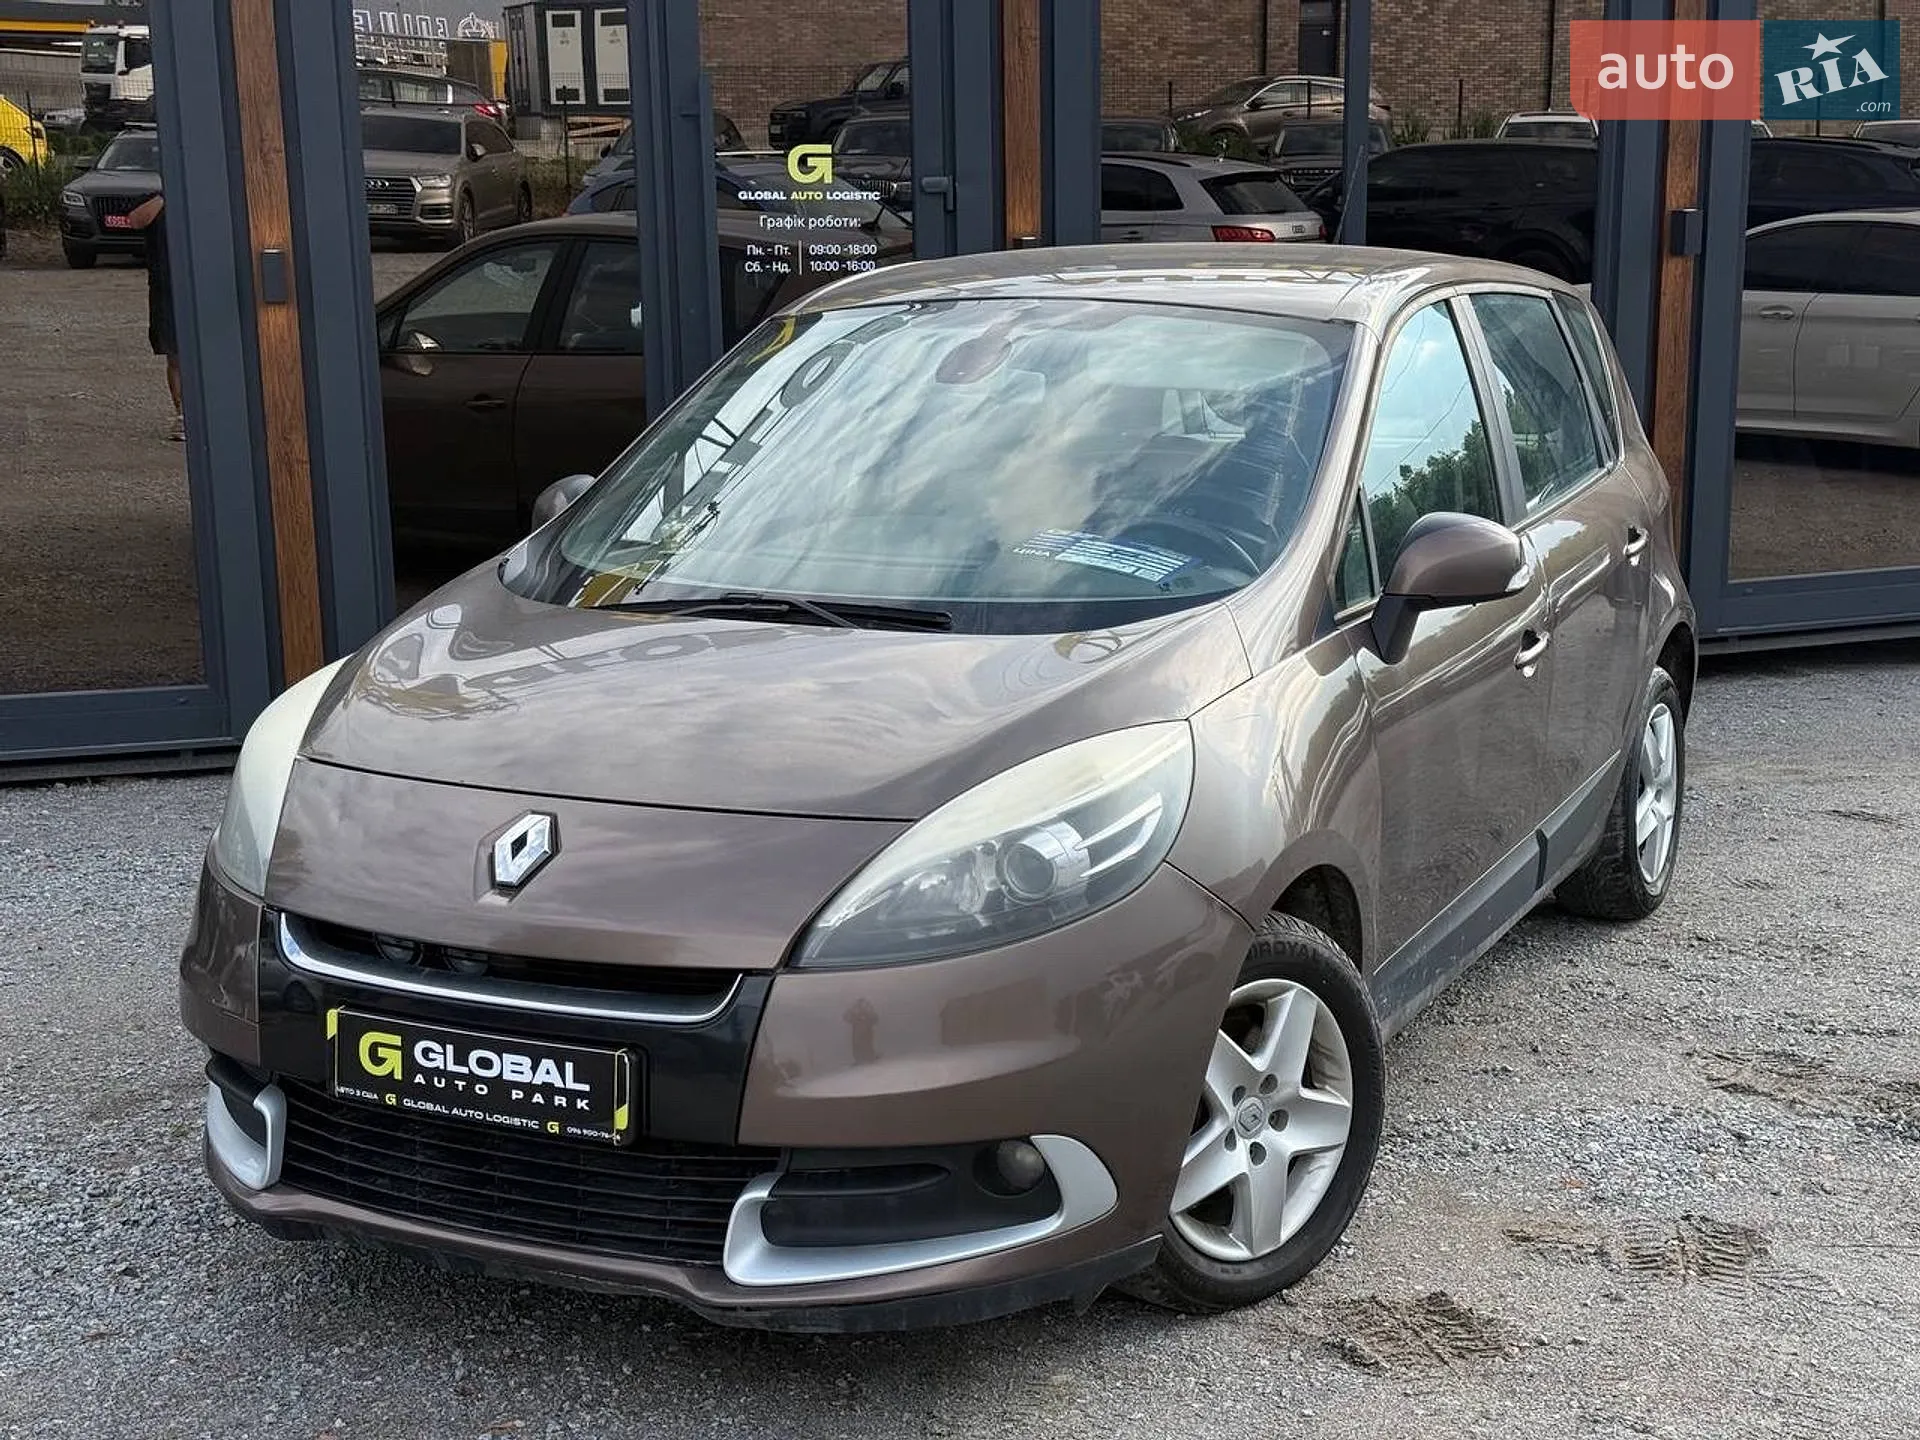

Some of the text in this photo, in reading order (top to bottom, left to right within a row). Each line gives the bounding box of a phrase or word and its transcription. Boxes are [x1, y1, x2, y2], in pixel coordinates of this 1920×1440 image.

[738, 190, 881, 200] GLOBAL AUTO LOGISTIC
[759, 214, 862, 230] Графік роботи:
[746, 244, 765, 256] Пн.
[774, 244, 792, 256] Пт.
[808, 244, 841, 255] 09:00
[744, 260, 763, 273] Сб.
[809, 261, 839, 272] 10:00
[413, 1040, 591, 1092] GLOBAL
[413, 1073, 591, 1111] AUTO PARK
[402, 1098, 540, 1130] GLOBAL AUTO LOGISTIC
